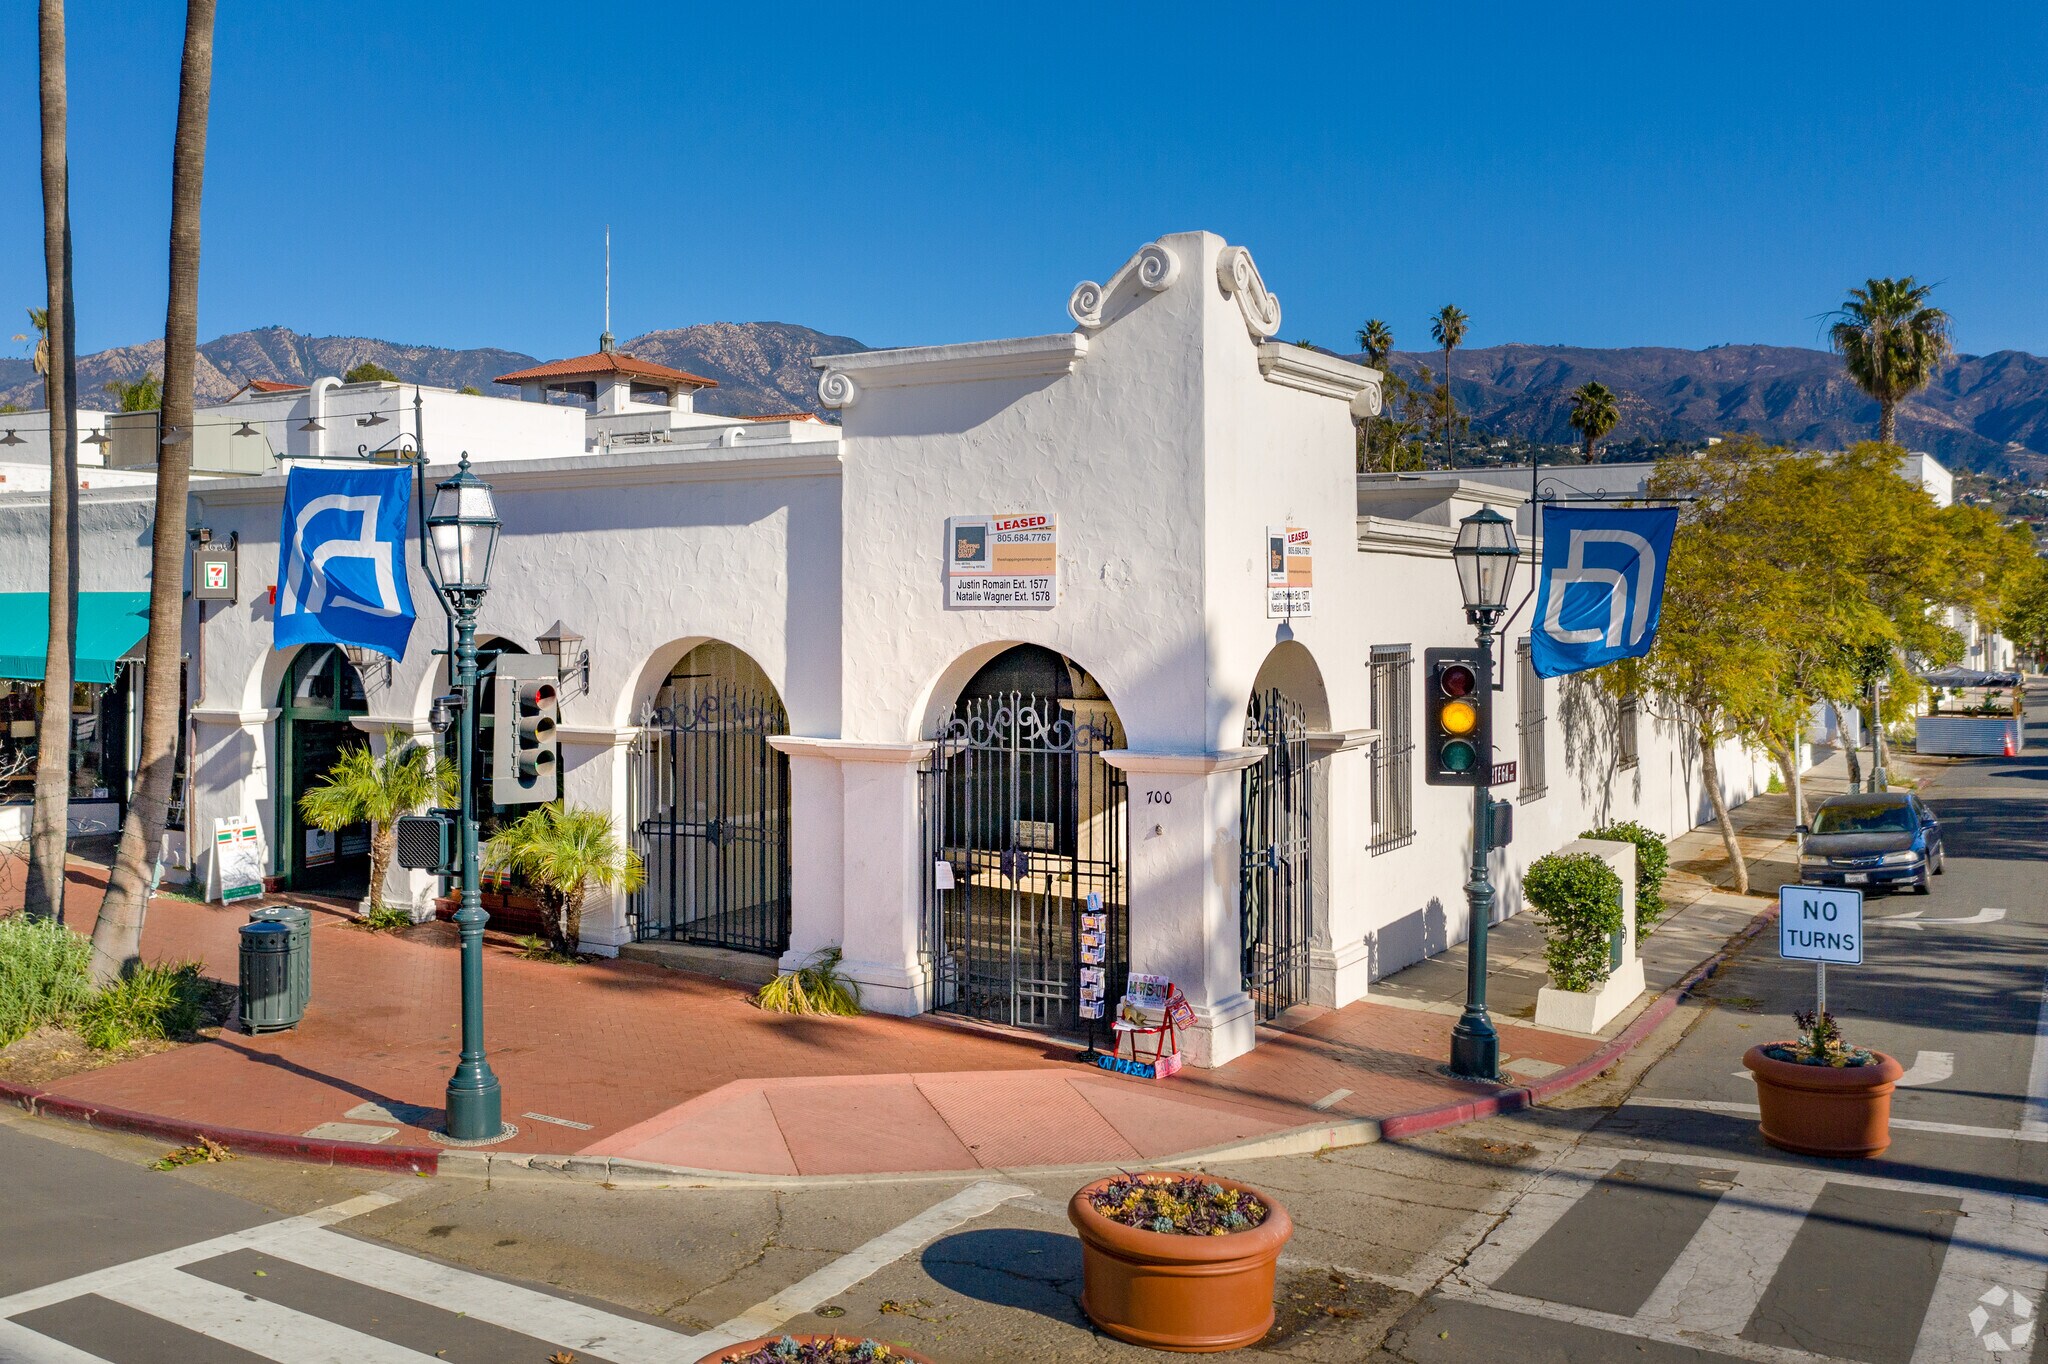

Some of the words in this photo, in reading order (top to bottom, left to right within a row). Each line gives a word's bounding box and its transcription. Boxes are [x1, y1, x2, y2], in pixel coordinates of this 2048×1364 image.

[996, 516, 1047, 531] LEASED
[997, 533, 1052, 543] 805.684.7767
[1287, 530, 1309, 543] LEASED
[210, 567, 222, 587] 7
[957, 579, 981, 589] Justin
[982, 579, 1011, 589] Romain
[1013, 579, 1027, 589] Ext.
[1029, 579, 1048, 589] 1577
[955, 591, 982, 601] Natalie
[983, 591, 1012, 604] Wagner
[1014, 591, 1029, 601] Ext.
[1031, 591, 1050, 601] 1578
[1146, 790, 1172, 804] 700
[1803, 900, 1838, 921] NO
[1787, 929, 1855, 951] TURNS
[1142, 975, 1159, 983] CAT
[1097, 1055, 1115, 1070] CAT
